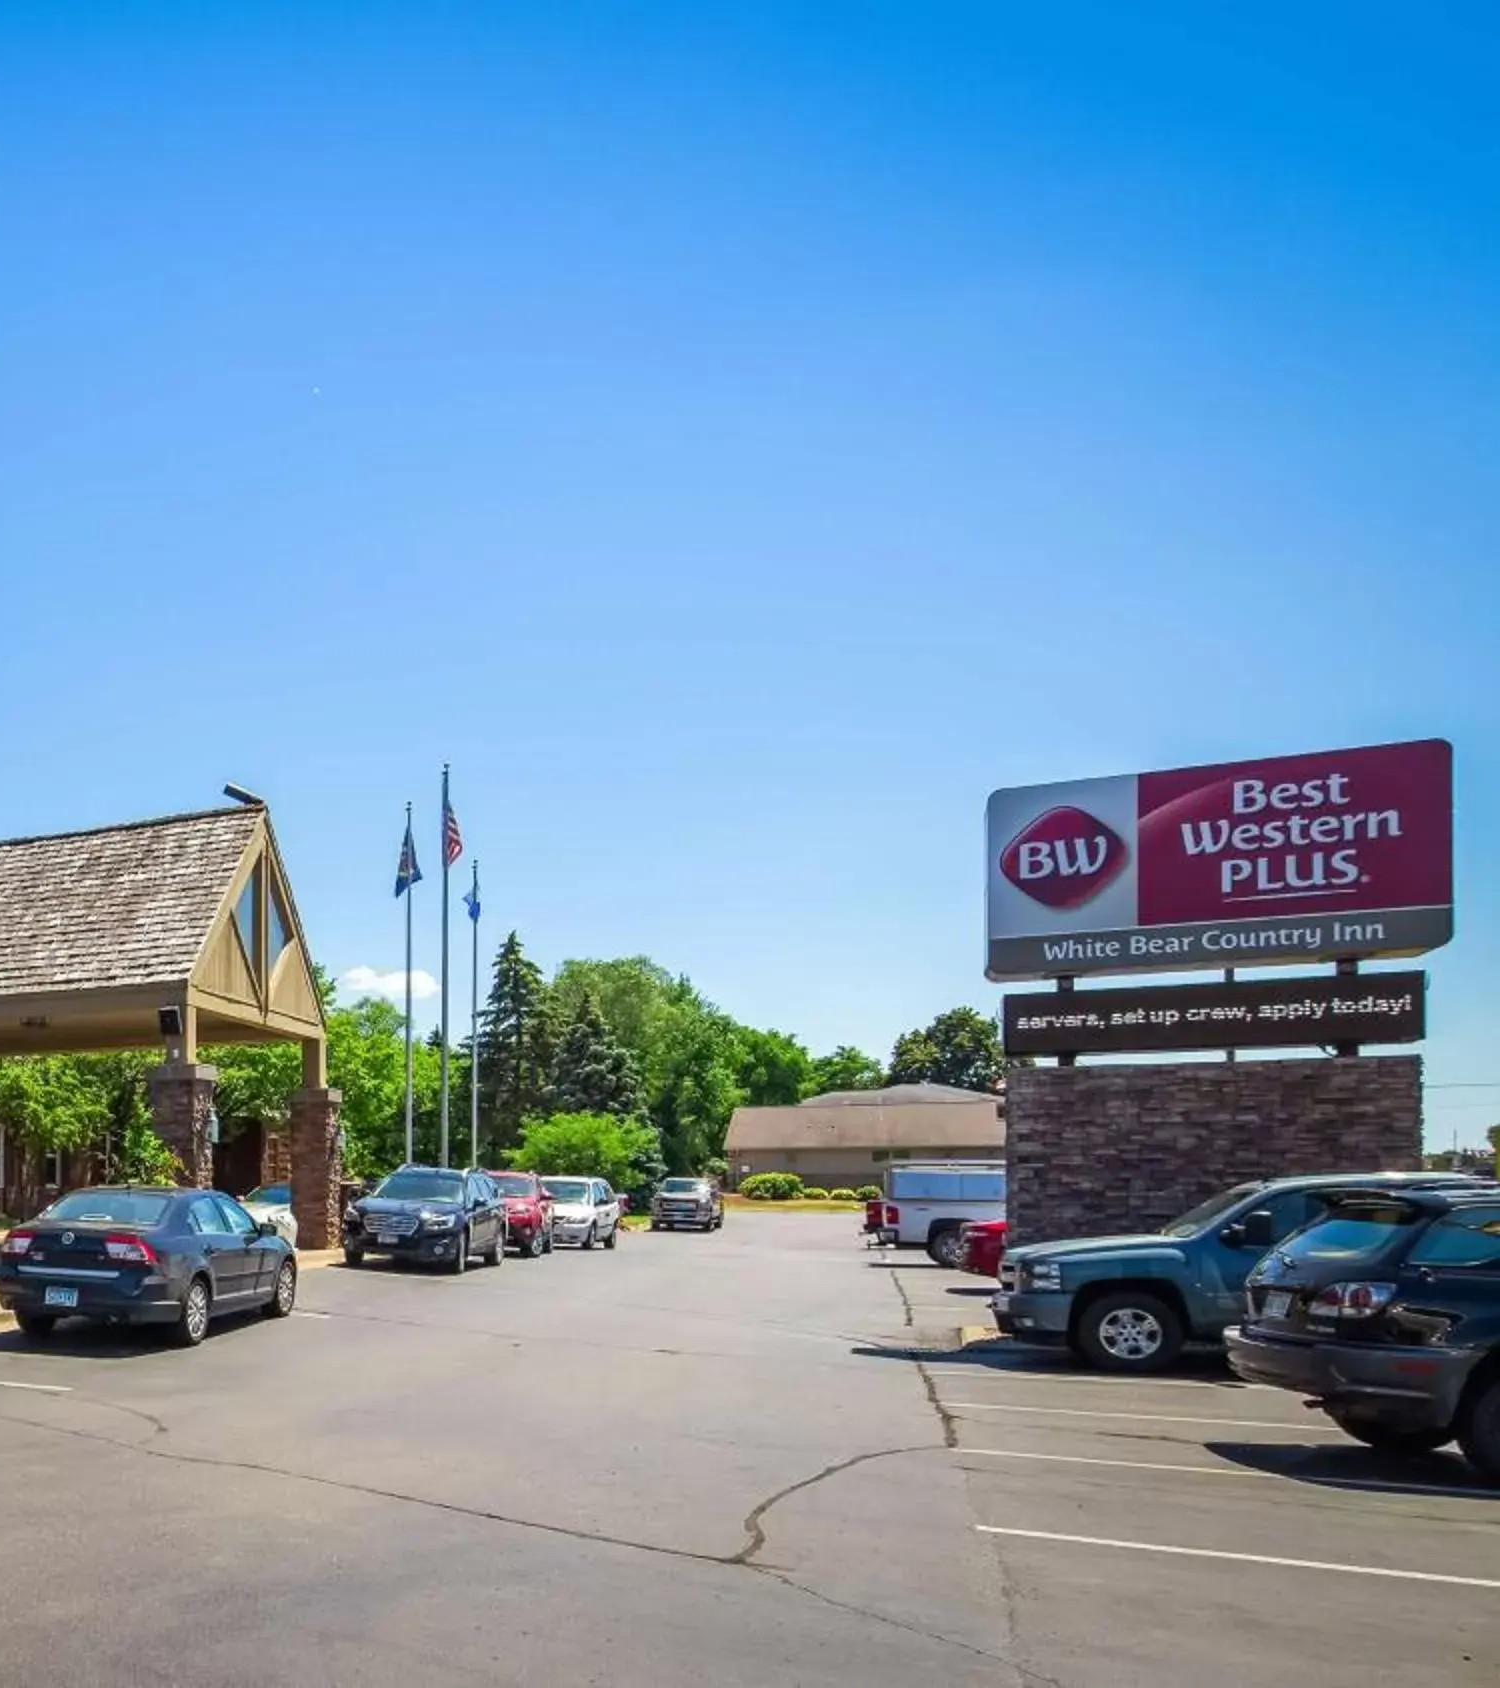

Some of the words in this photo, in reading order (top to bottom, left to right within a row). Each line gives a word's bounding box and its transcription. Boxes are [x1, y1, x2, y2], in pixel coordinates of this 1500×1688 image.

[1232, 773, 1350, 814] Best
[1181, 808, 1403, 855] Western
[1018, 835, 1107, 880] BW
[1043, 938, 1121, 961] White
[1129, 935, 1195, 955] Bear
[1201, 927, 1322, 950] Country
[1332, 921, 1387, 942] Inn
[1110, 1008, 1146, 1025] set
[1149, 1010, 1181, 1026] up
[1257, 999, 1328, 1020] apply
